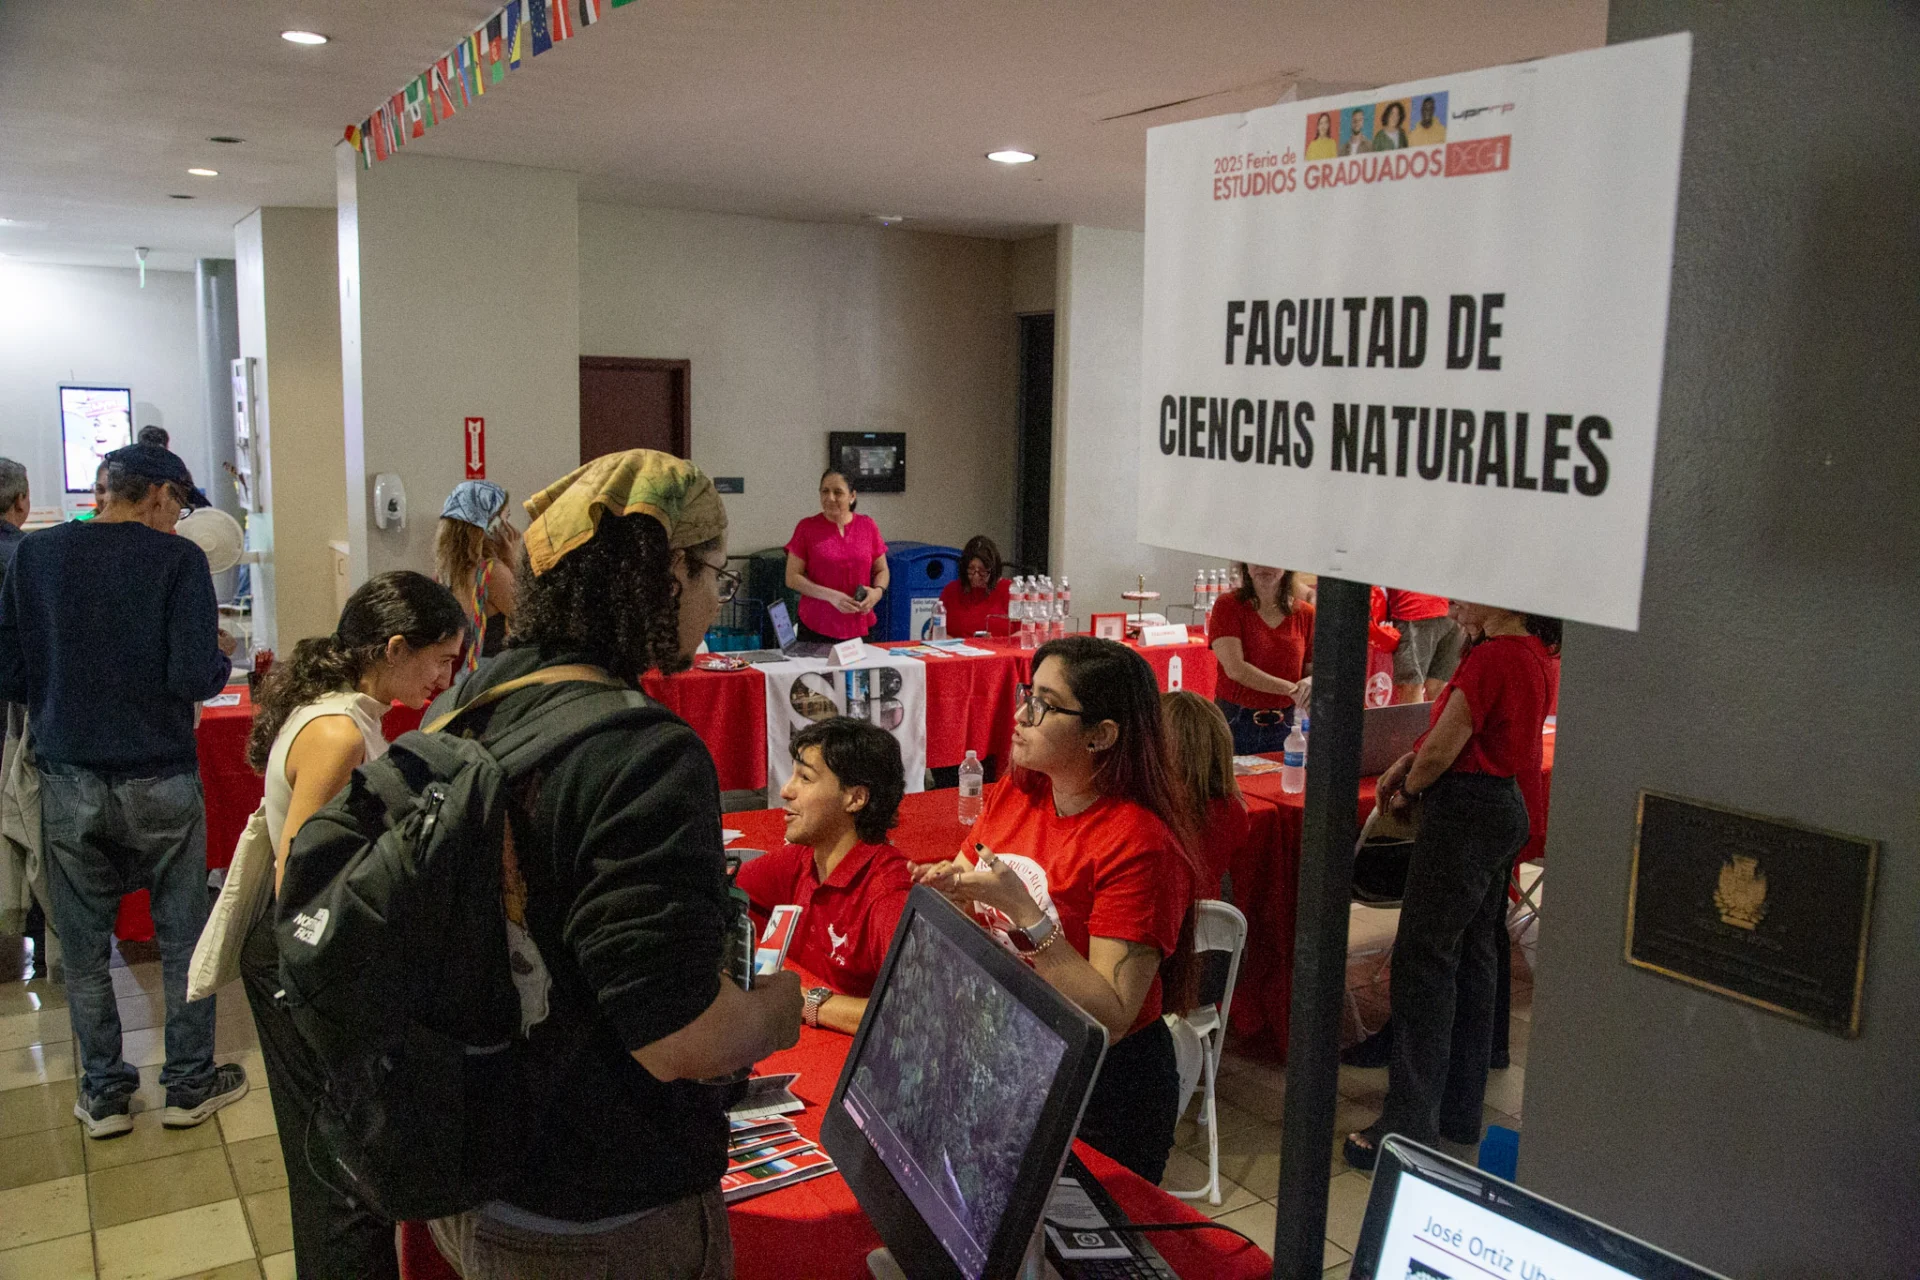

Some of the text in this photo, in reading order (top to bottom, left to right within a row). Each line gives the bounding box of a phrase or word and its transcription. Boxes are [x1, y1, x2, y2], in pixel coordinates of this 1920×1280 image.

[1213, 147, 1297, 174] 2025 Feria de
[1213, 149, 1443, 201] ESTUDIOS GRADUADOS
[1225, 292, 1506, 371] FACULTAD DE
[1159, 394, 1613, 498] CIENCIAS NATURALES
[1423, 1215, 1556, 1280] José Ortiz Ub
